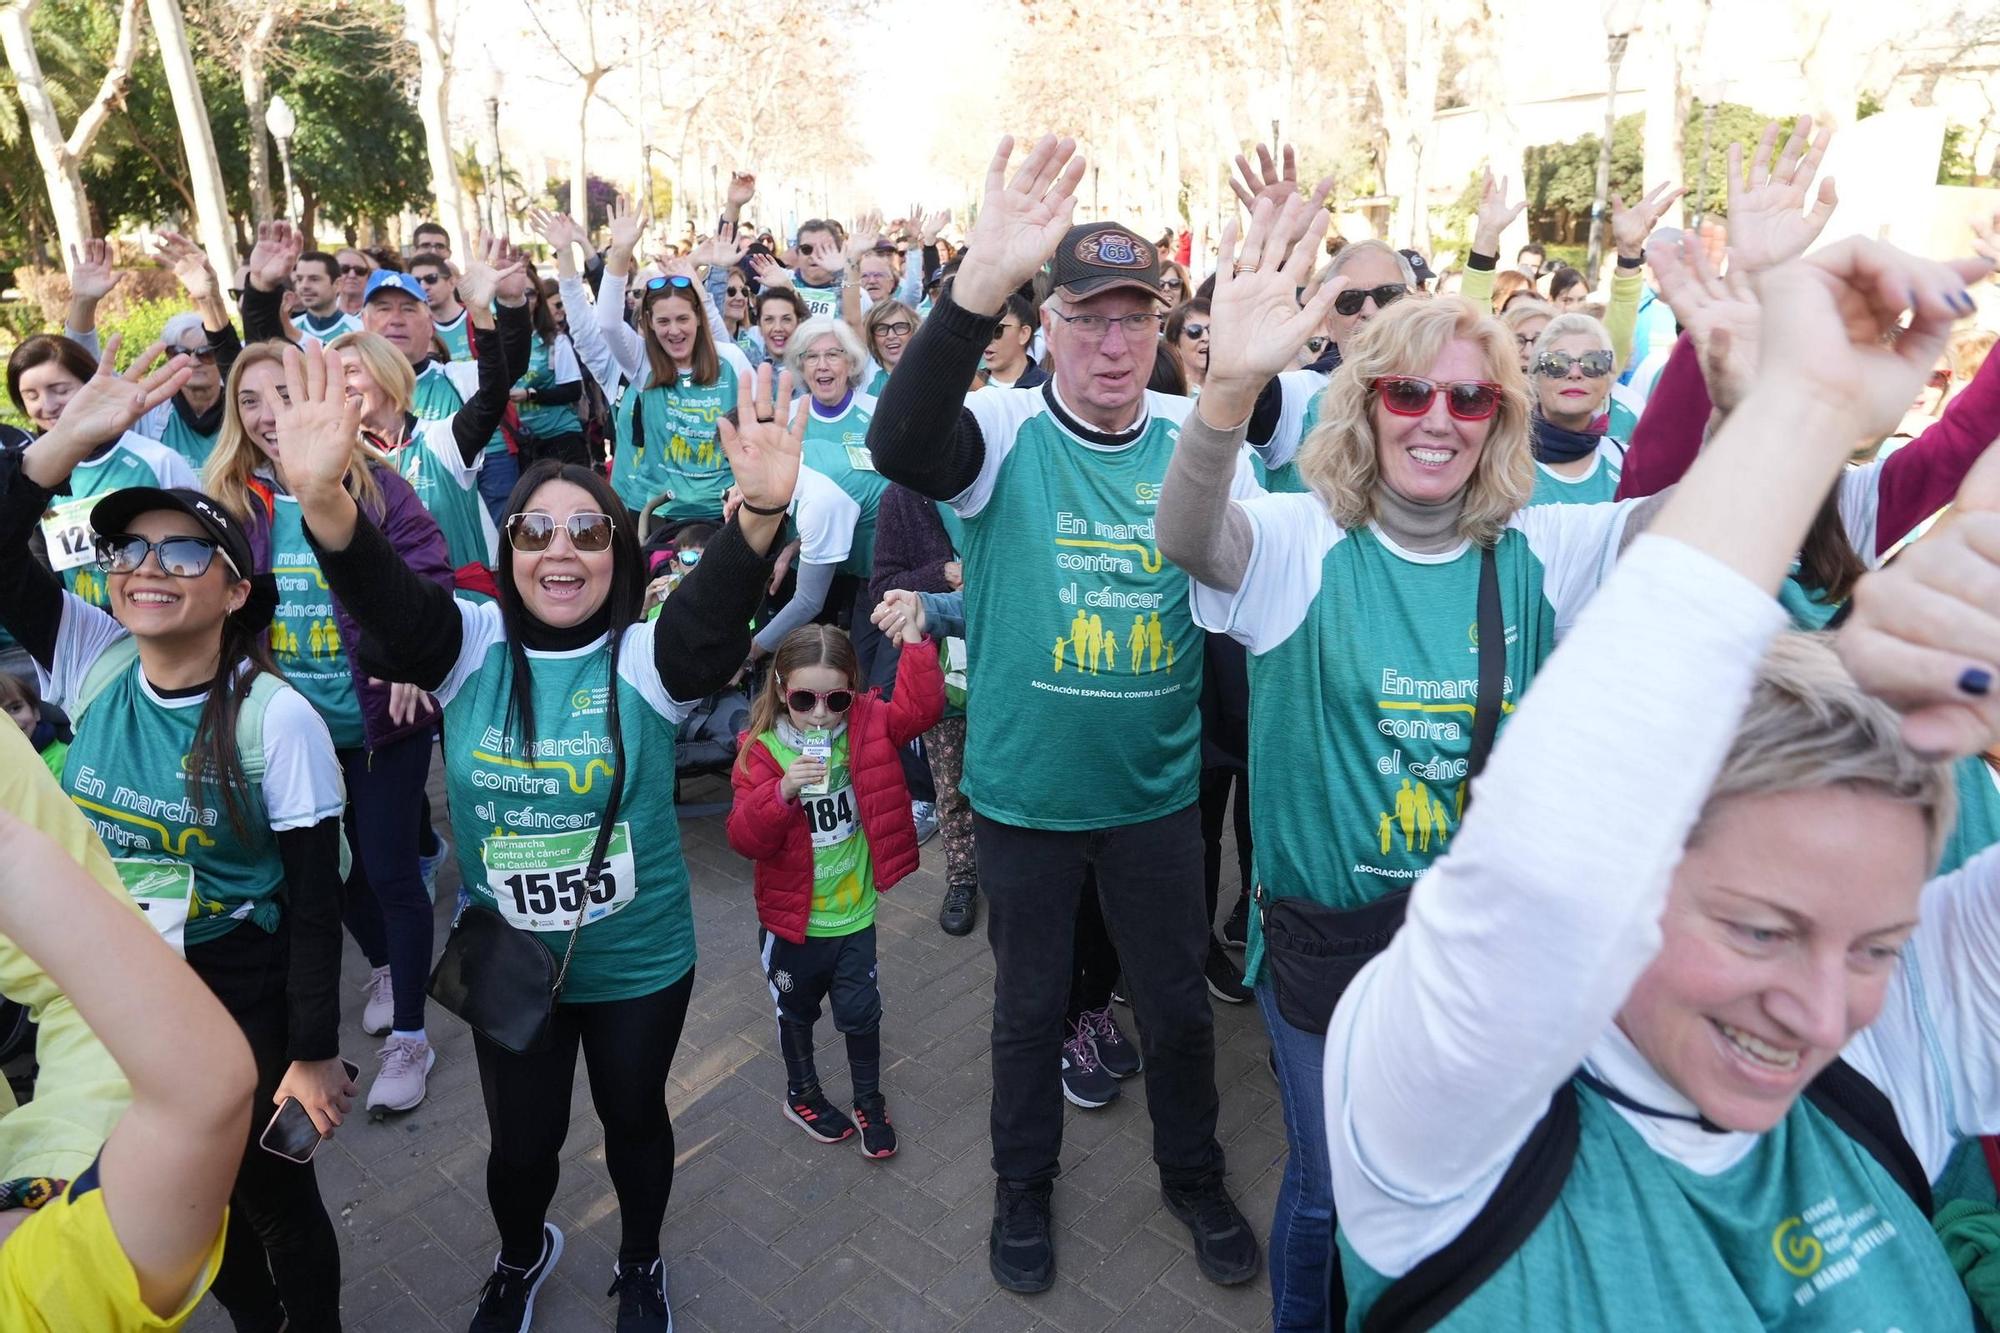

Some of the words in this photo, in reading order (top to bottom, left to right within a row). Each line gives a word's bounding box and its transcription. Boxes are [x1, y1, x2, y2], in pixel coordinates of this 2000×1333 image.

[1107, 244, 1127, 259] 66
[1056, 511, 1087, 535] En
[1055, 552, 1133, 574] contra
[1058, 582, 1077, 605] el
[1084, 585, 1164, 609] cáncer
[1031, 679, 1080, 696] ASOCIACIÓN
[1080, 688, 1123, 699] ESPAÑOLA
[1123, 690, 1154, 699] CONTRA
[1382, 668, 1414, 695] En
[479, 725, 514, 753] En
[522, 731, 615, 758] marcha
[1378, 718, 1460, 740] contra
[1377, 749, 1401, 775] el
[1408, 755, 1469, 780] cánc
[471, 769, 560, 795] contra
[74, 765, 106, 799] En
[111, 785, 218, 827] marcha
[474, 801, 496, 823] el
[504, 805, 596, 829] cáncer
[802, 790, 853, 834] 184
[492, 850, 524, 860] contra
[524, 848, 537, 859] el
[536, 846, 572, 859] cáncer
[508, 839, 546, 850] marcha
[506, 858, 549, 870] Castelló
[1353, 864, 1414, 879] ASOCIACIÓN
[503, 860, 617, 916] 1555
